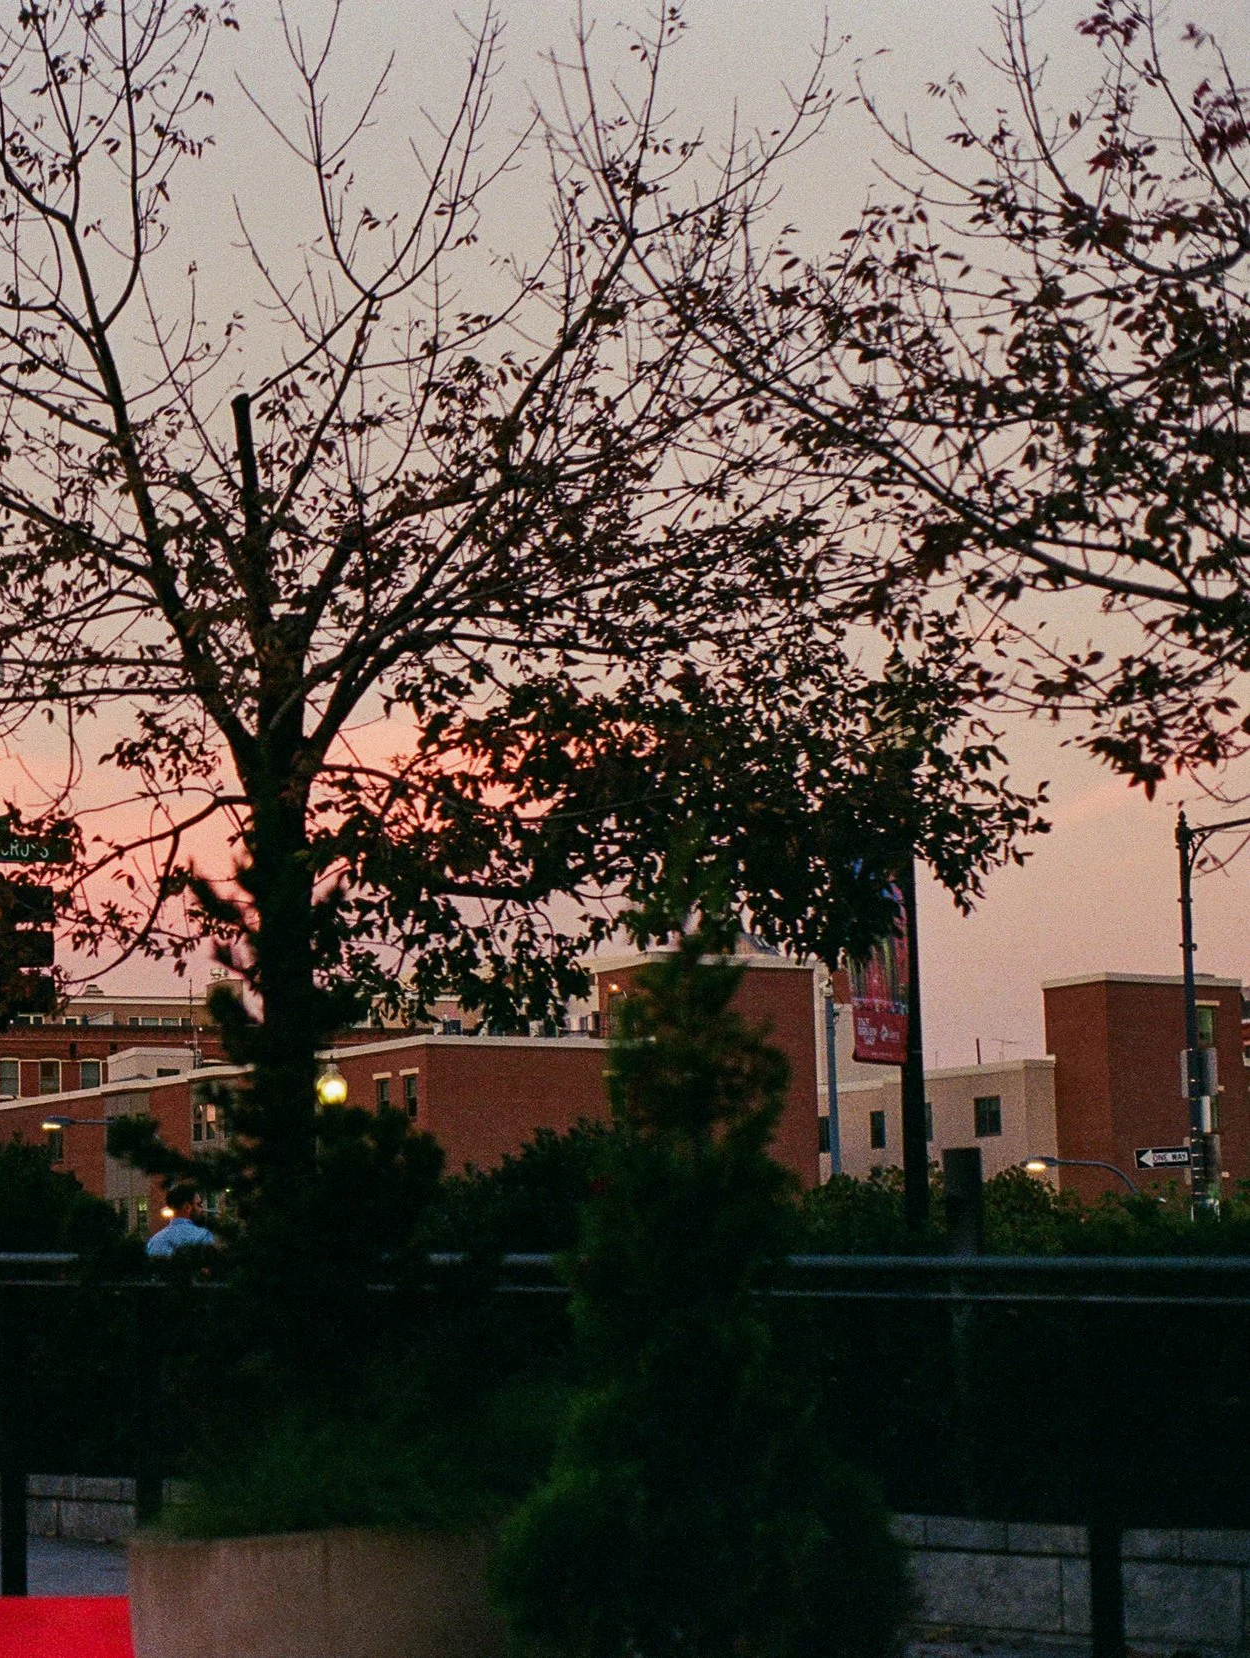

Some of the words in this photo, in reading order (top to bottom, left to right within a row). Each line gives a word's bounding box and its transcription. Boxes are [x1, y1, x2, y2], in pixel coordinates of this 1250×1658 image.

[0, 838, 49, 859] ROS
[1152, 1153, 1167, 1162] ONE
[1171, 1153, 1186, 1161] WAY
